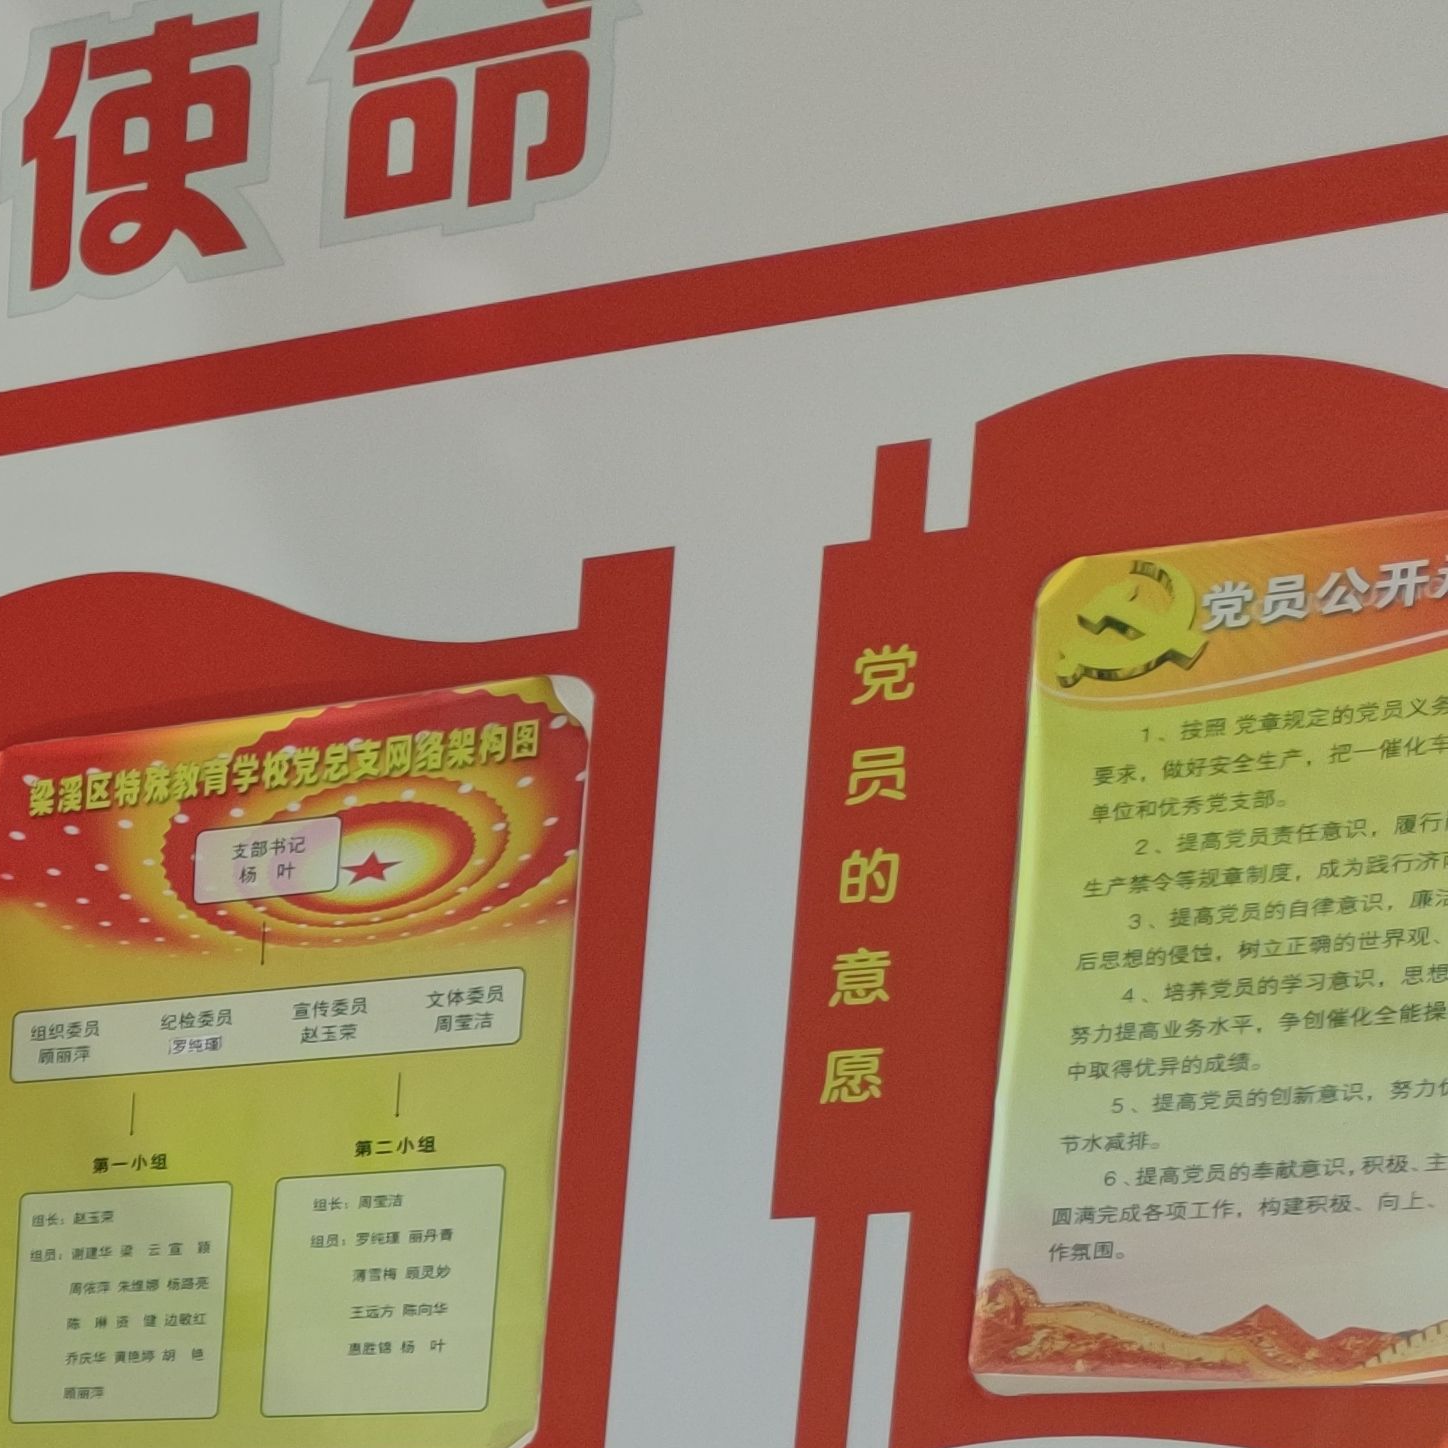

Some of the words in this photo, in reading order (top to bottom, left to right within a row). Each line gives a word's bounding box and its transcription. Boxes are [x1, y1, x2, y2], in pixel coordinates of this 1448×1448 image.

[1201, 557, 1448, 631] 党员公开
[29, 719, 540, 818] 梁溪区特殊教育学校党总支网络架构图
[232, 836, 306, 860] 支部书记
[819, 644, 917, 1106] 党员的意愿
[30, 1020, 100, 1042] 组织委员
[160, 1009, 233, 1031] 纪检委员
[292, 997, 368, 1020] 宣传委员
[426, 985, 504, 1009] 文体委员
[38, 1046, 91, 1064] 顾丽萍
[300, 1024, 358, 1043] 赵玉荣
[435, 1012, 494, 1033] 周莹洁
[92, 1153, 167, 1174] 第一小组
[353, 1136, 436, 1158] 第二小组
